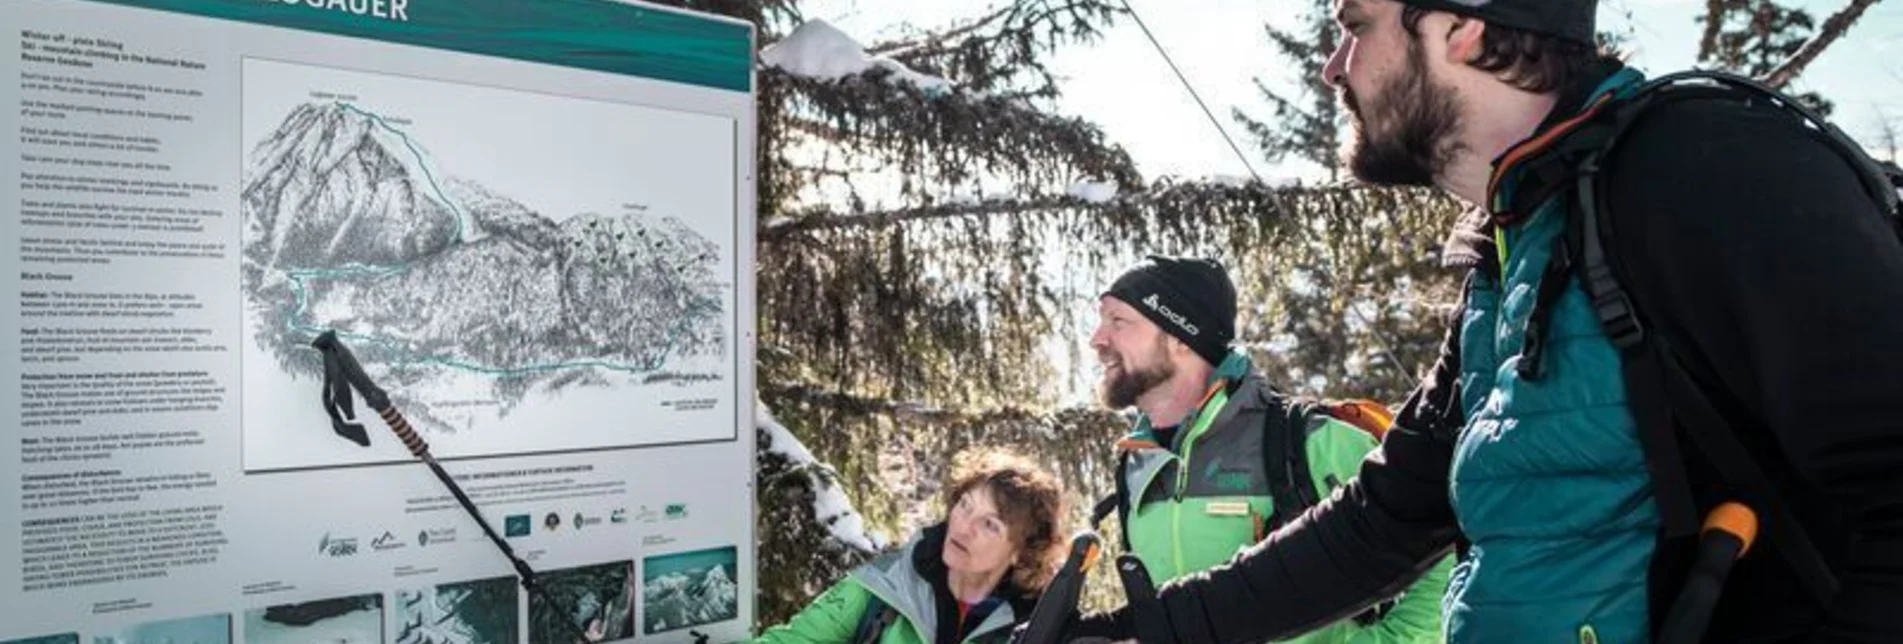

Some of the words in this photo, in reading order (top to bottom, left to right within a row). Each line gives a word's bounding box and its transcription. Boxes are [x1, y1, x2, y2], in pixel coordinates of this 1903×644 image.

[21, 31, 50, 42] Winter
[42, 44, 81, 56] mountain
[84, 48, 119, 62] climbing
[121, 52, 128, 61] in
[131, 53, 143, 63] the
[146, 55, 178, 67] National
[21, 272, 43, 280] Black
[45, 272, 72, 281] Grouse
[1158, 304, 1199, 336] odlo
